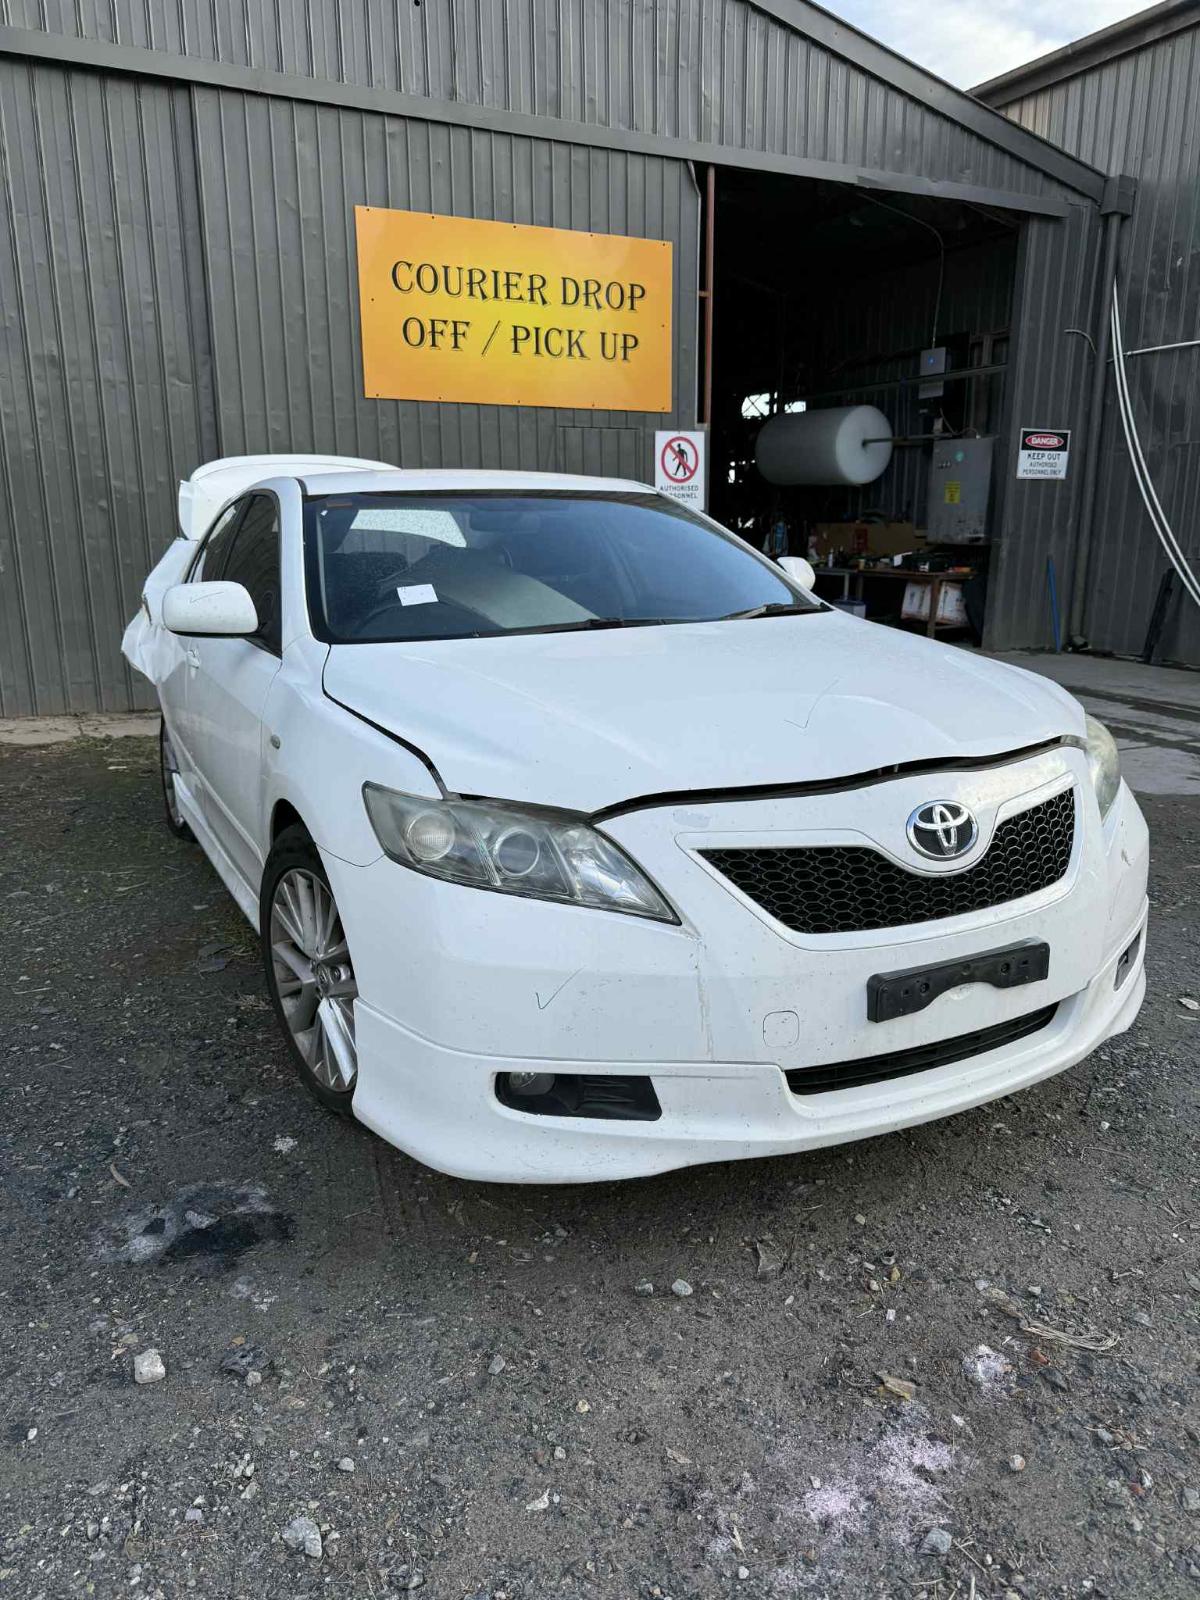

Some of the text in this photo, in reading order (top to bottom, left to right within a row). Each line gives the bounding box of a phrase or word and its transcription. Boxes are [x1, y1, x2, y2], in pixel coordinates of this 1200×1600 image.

[391, 260, 646, 312] COURIER DROP
[402, 316, 639, 362] OFF / PICK UP
[1031, 437, 1058, 445] DANGER
[1047, 453, 1061, 461] OUT
